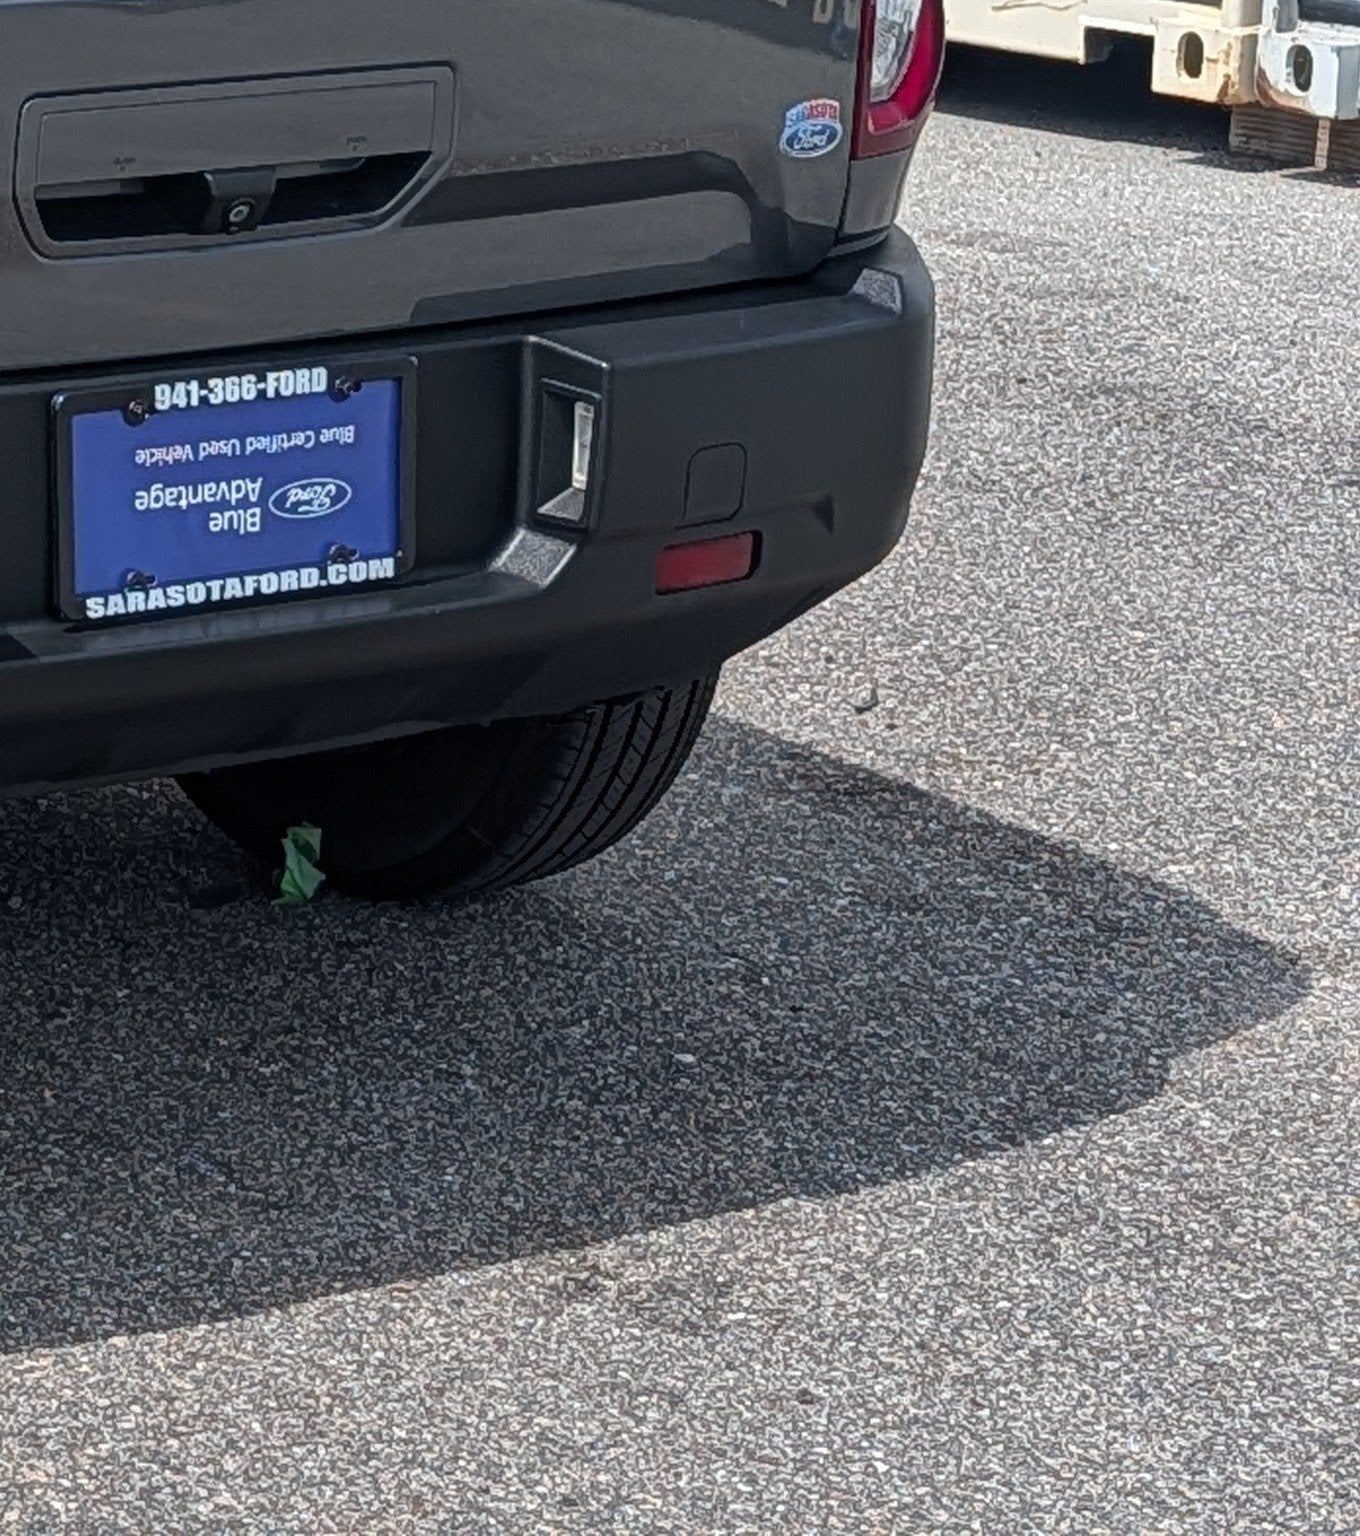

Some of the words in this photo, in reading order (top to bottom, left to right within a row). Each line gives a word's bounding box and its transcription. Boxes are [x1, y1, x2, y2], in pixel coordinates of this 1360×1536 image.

[154, 366, 328, 411] 941-366-FORD
[245, 430, 316, 456] Certified
[319, 424, 356, 444] Blue
[135, 442, 194, 467] Vehicle
[198, 437, 241, 461] Used
[134, 476, 264, 511] Advantage
[208, 507, 262, 535] Blue
[85, 556, 396, 620] SARASOTAFORD.COM
